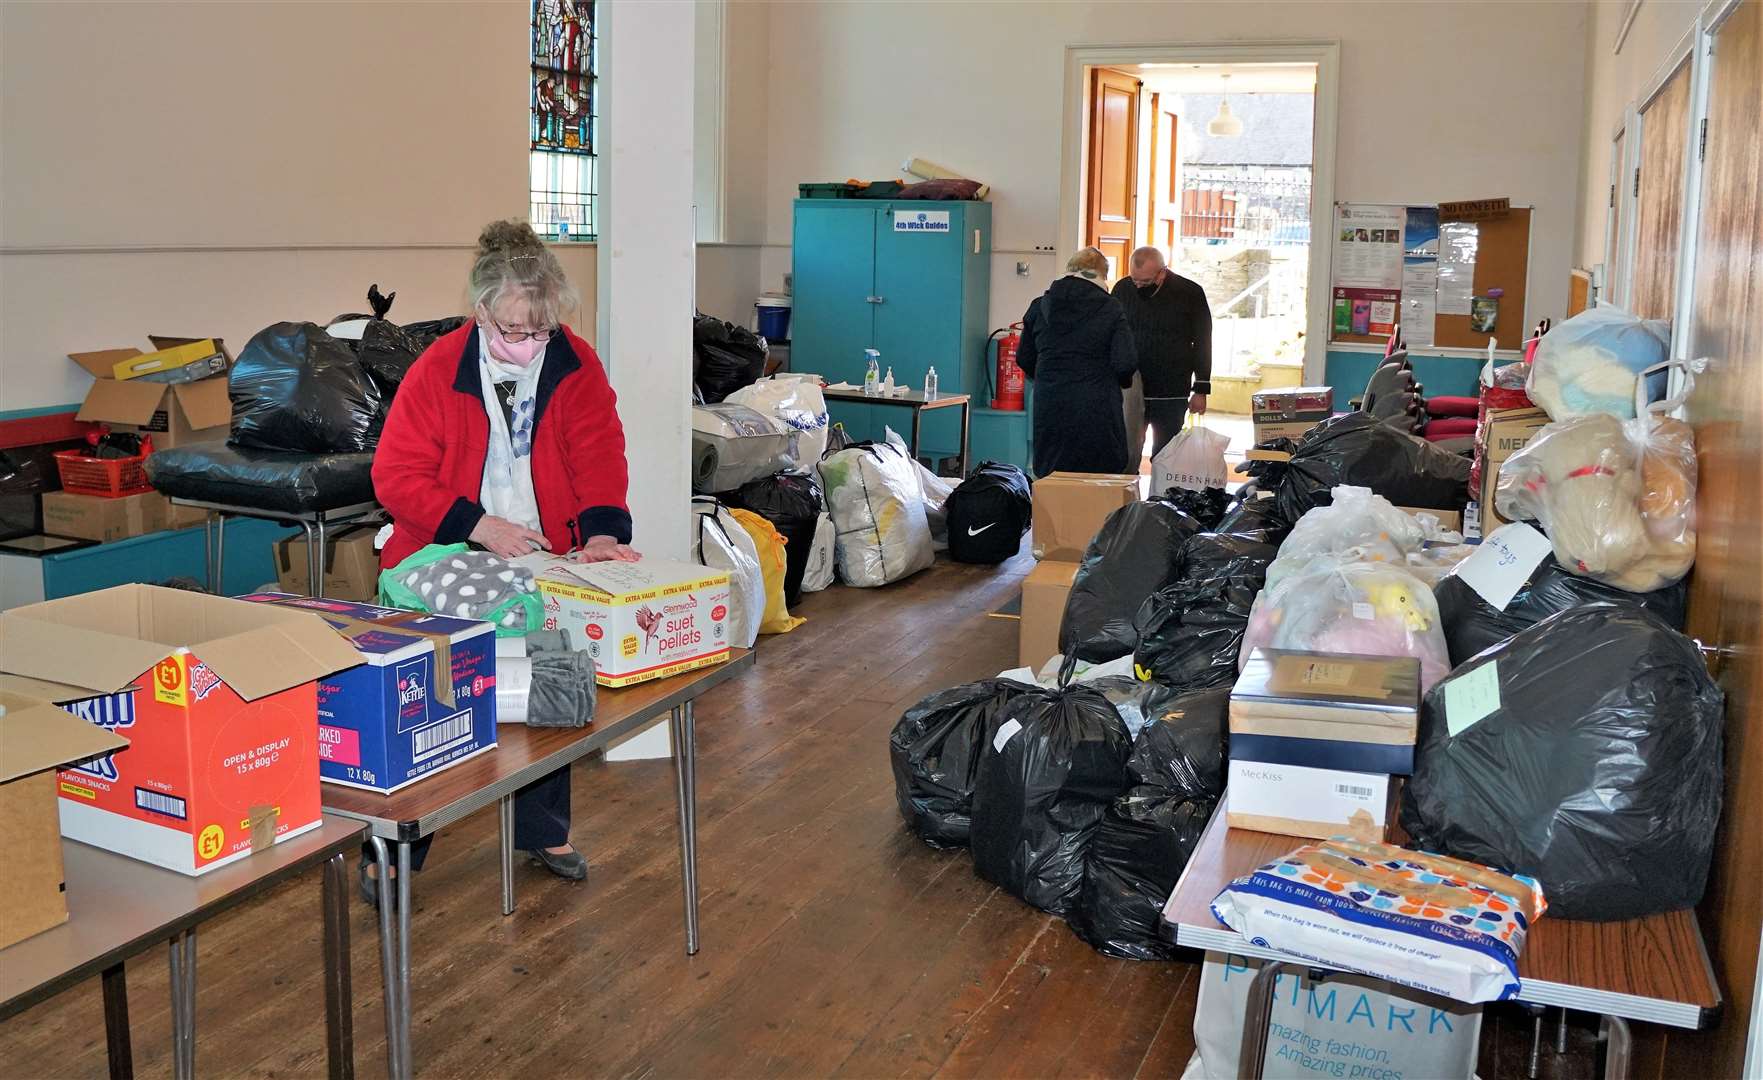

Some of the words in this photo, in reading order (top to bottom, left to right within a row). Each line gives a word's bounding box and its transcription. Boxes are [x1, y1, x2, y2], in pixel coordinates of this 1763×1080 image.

[561, 589, 576, 597] VALUE
[580, 592, 595, 600] EXTRA
[624, 595, 640, 603] EXTRA
[641, 591, 656, 600] VALUE
[663, 587, 678, 595] EXTRA
[679, 584, 693, 592] VALUE
[699, 580, 713, 588] EXTRA
[714, 577, 728, 586] VALUE
[544, 616, 557, 630] et
[666, 613, 694, 633] suet
[623, 636, 637, 644] EXTRA
[623, 642, 637, 650] VALUE
[659, 630, 701, 656] pellets
[624, 648, 637, 656] PACK
[161, 665, 177, 684] £1
[624, 676, 640, 685] EXTRA
[641, 672, 656, 681] VALUE
[662, 667, 677, 675] EXTRA
[678, 663, 692, 671] VALUE
[698, 657, 712, 666] EXTRA
[712, 654, 726, 663] VALUE
[401, 687, 425, 705] KETTLE
[224, 753, 246, 768] OPEN
[248, 750, 255, 760] &
[256, 737, 290, 756] DISPLAY
[236, 763, 247, 774] 15
[347, 767, 354, 778] 12
[356, 769, 361, 780] X
[362, 770, 375, 785] 80g
[1241, 768, 1283, 782] MecKiss
[87, 778, 111, 792] SNACKS
[203, 832, 219, 854] £1
[1252, 876, 1267, 888] THIS
[1269, 879, 1282, 890] BAG
[1285, 883, 1292, 893] IS
[1295, 887, 1312, 899] MADE
[1315, 893, 1333, 906] FROM
[1264, 909, 1280, 918] When
[1281, 914, 1292, 922] this
[1293, 916, 1305, 926] bag
[1352, 931, 1362, 940] will
[1362, 935, 1386, 947] replace
[1394, 944, 1406, 953] free
[1270, 1022, 1321, 1054] mazing
[1276, 1044, 1346, 1078] Amazing
[1350, 1062, 1404, 1080] prices
